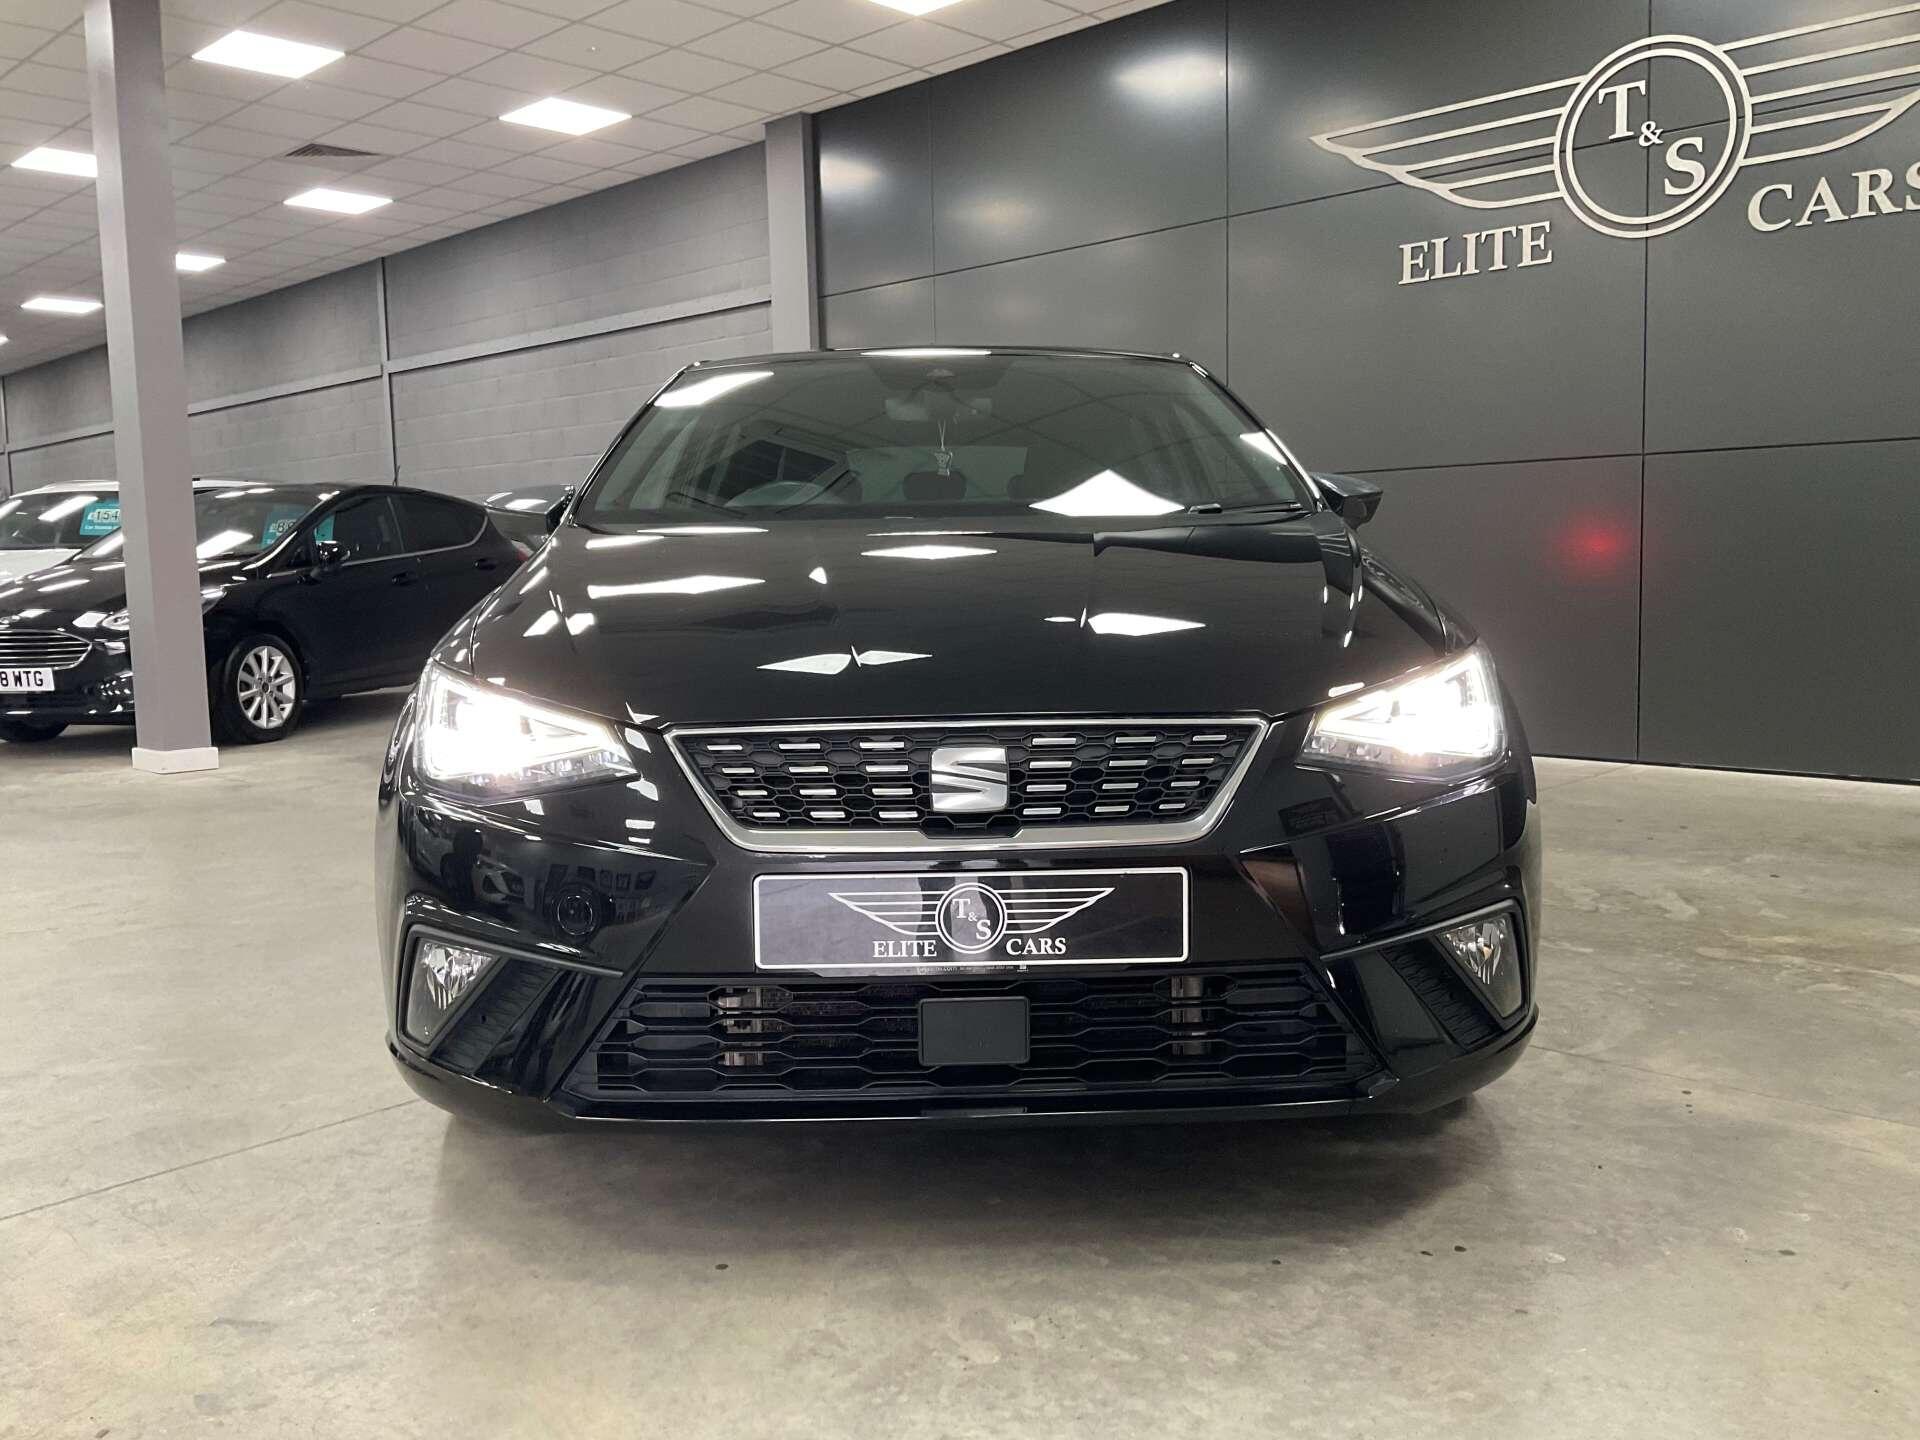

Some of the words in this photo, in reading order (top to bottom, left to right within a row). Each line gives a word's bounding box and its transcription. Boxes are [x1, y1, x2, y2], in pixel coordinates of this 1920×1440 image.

[1398, 220, 1553, 285] ELITE
[12, 670, 44, 687] WTG
[873, 940, 937, 958] ELITE
[1006, 937, 1066, 956] CARS
